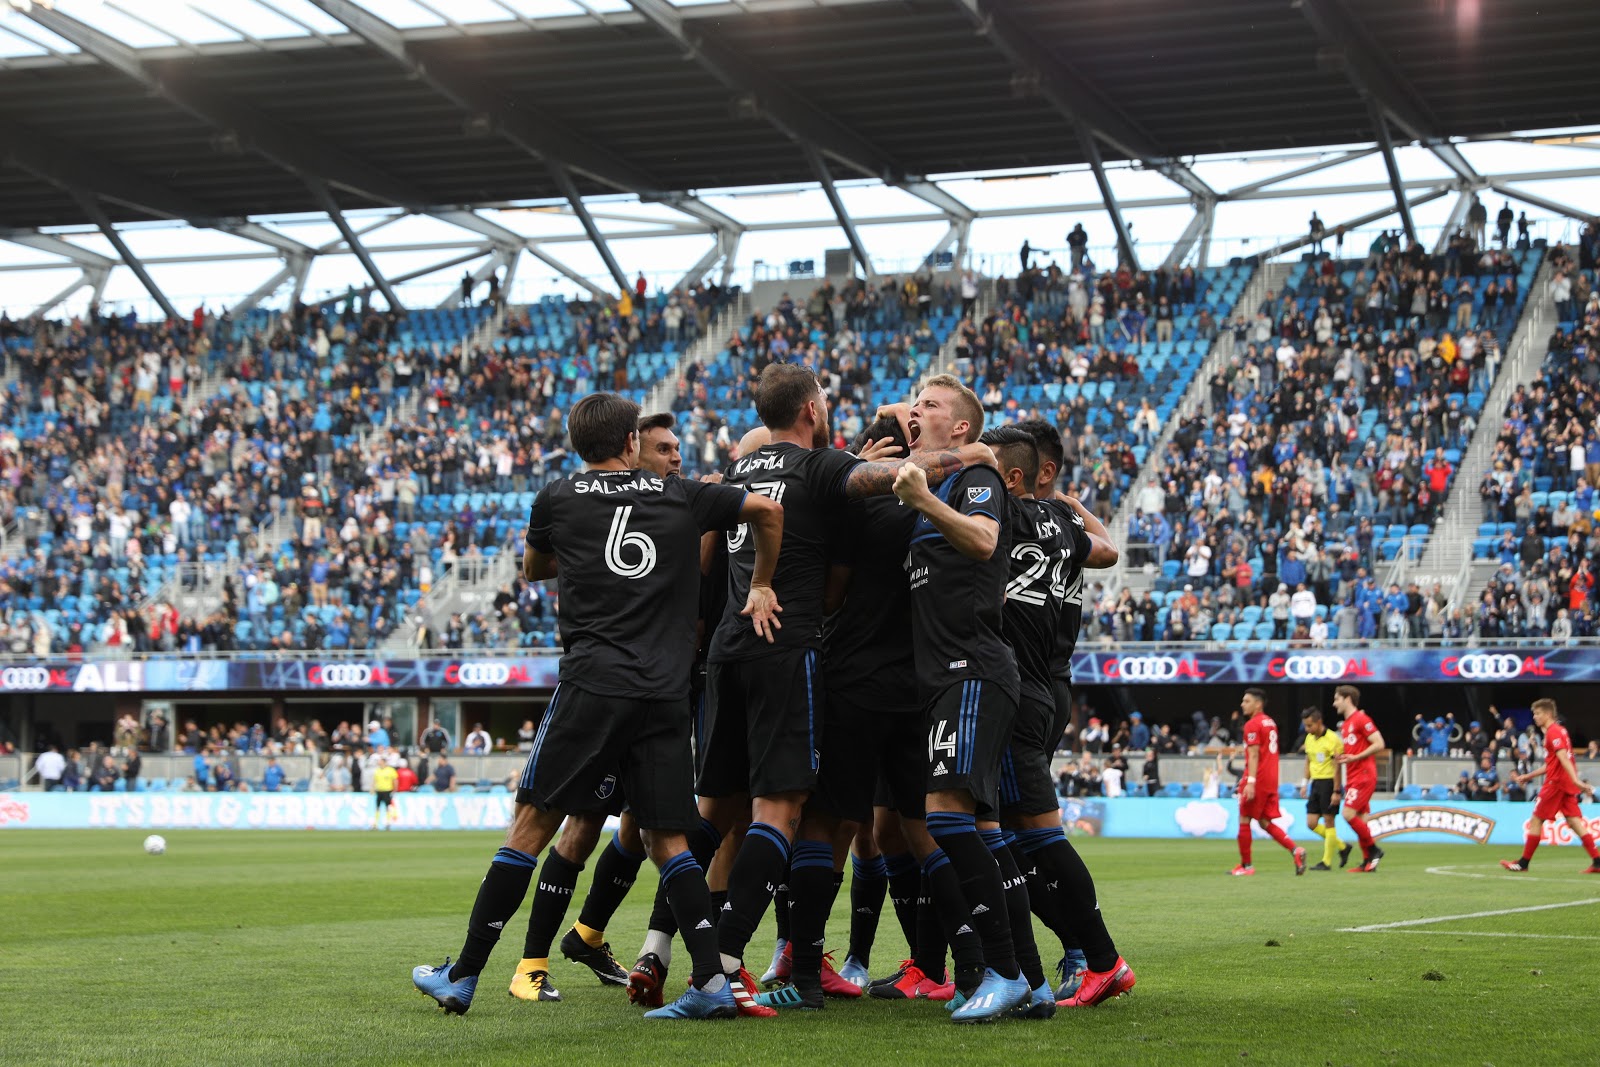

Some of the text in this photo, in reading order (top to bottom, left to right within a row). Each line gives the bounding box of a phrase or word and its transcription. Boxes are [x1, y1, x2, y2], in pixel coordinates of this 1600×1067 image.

[575, 477, 664, 494] SALINAS
[604, 505, 657, 580] 6
[928, 720, 956, 763] 14
[1268, 729, 1278, 755] 8
[88, 793, 145, 825] IT'S
[149, 796, 212, 825] BEN
[216, 796, 242, 826] &
[636, 965, 653, 975] COPA
